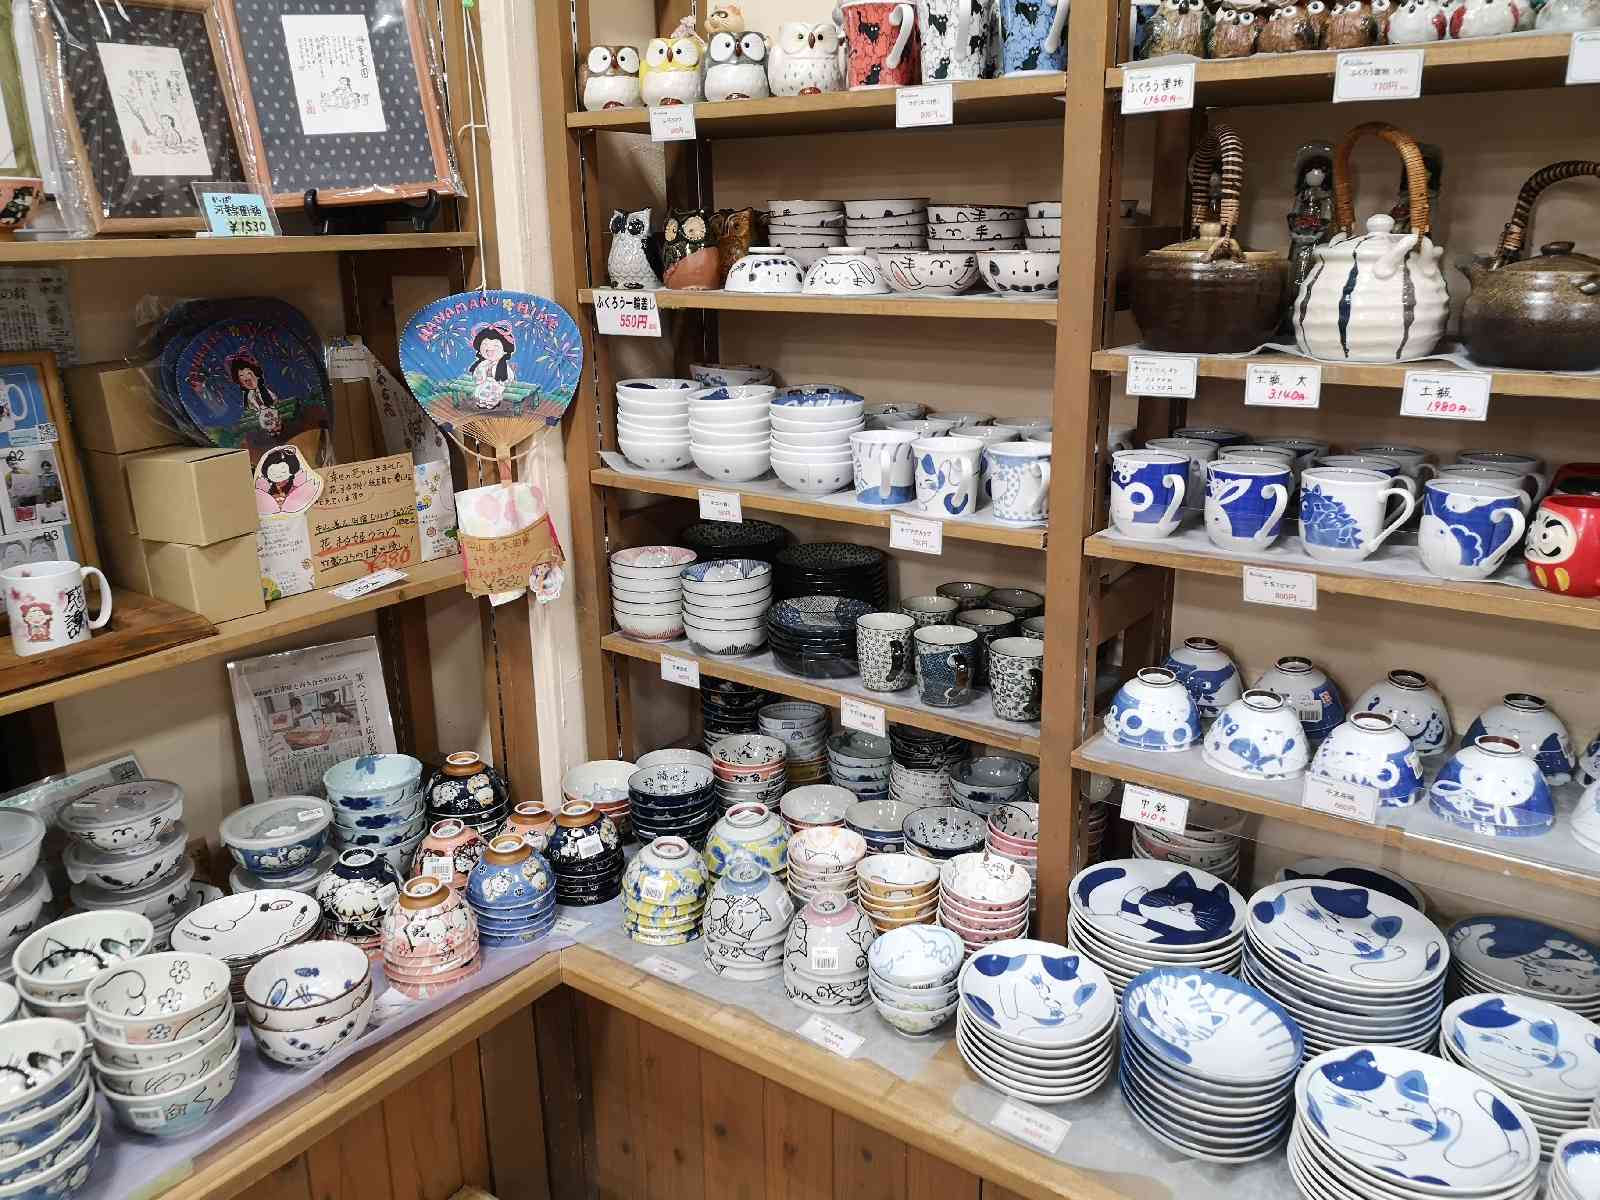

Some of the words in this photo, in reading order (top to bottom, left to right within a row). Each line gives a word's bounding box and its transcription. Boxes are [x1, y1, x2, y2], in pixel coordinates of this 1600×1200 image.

[596, 295, 656, 311] ふくろう一輪差し
[619, 312, 648, 329] 550円
